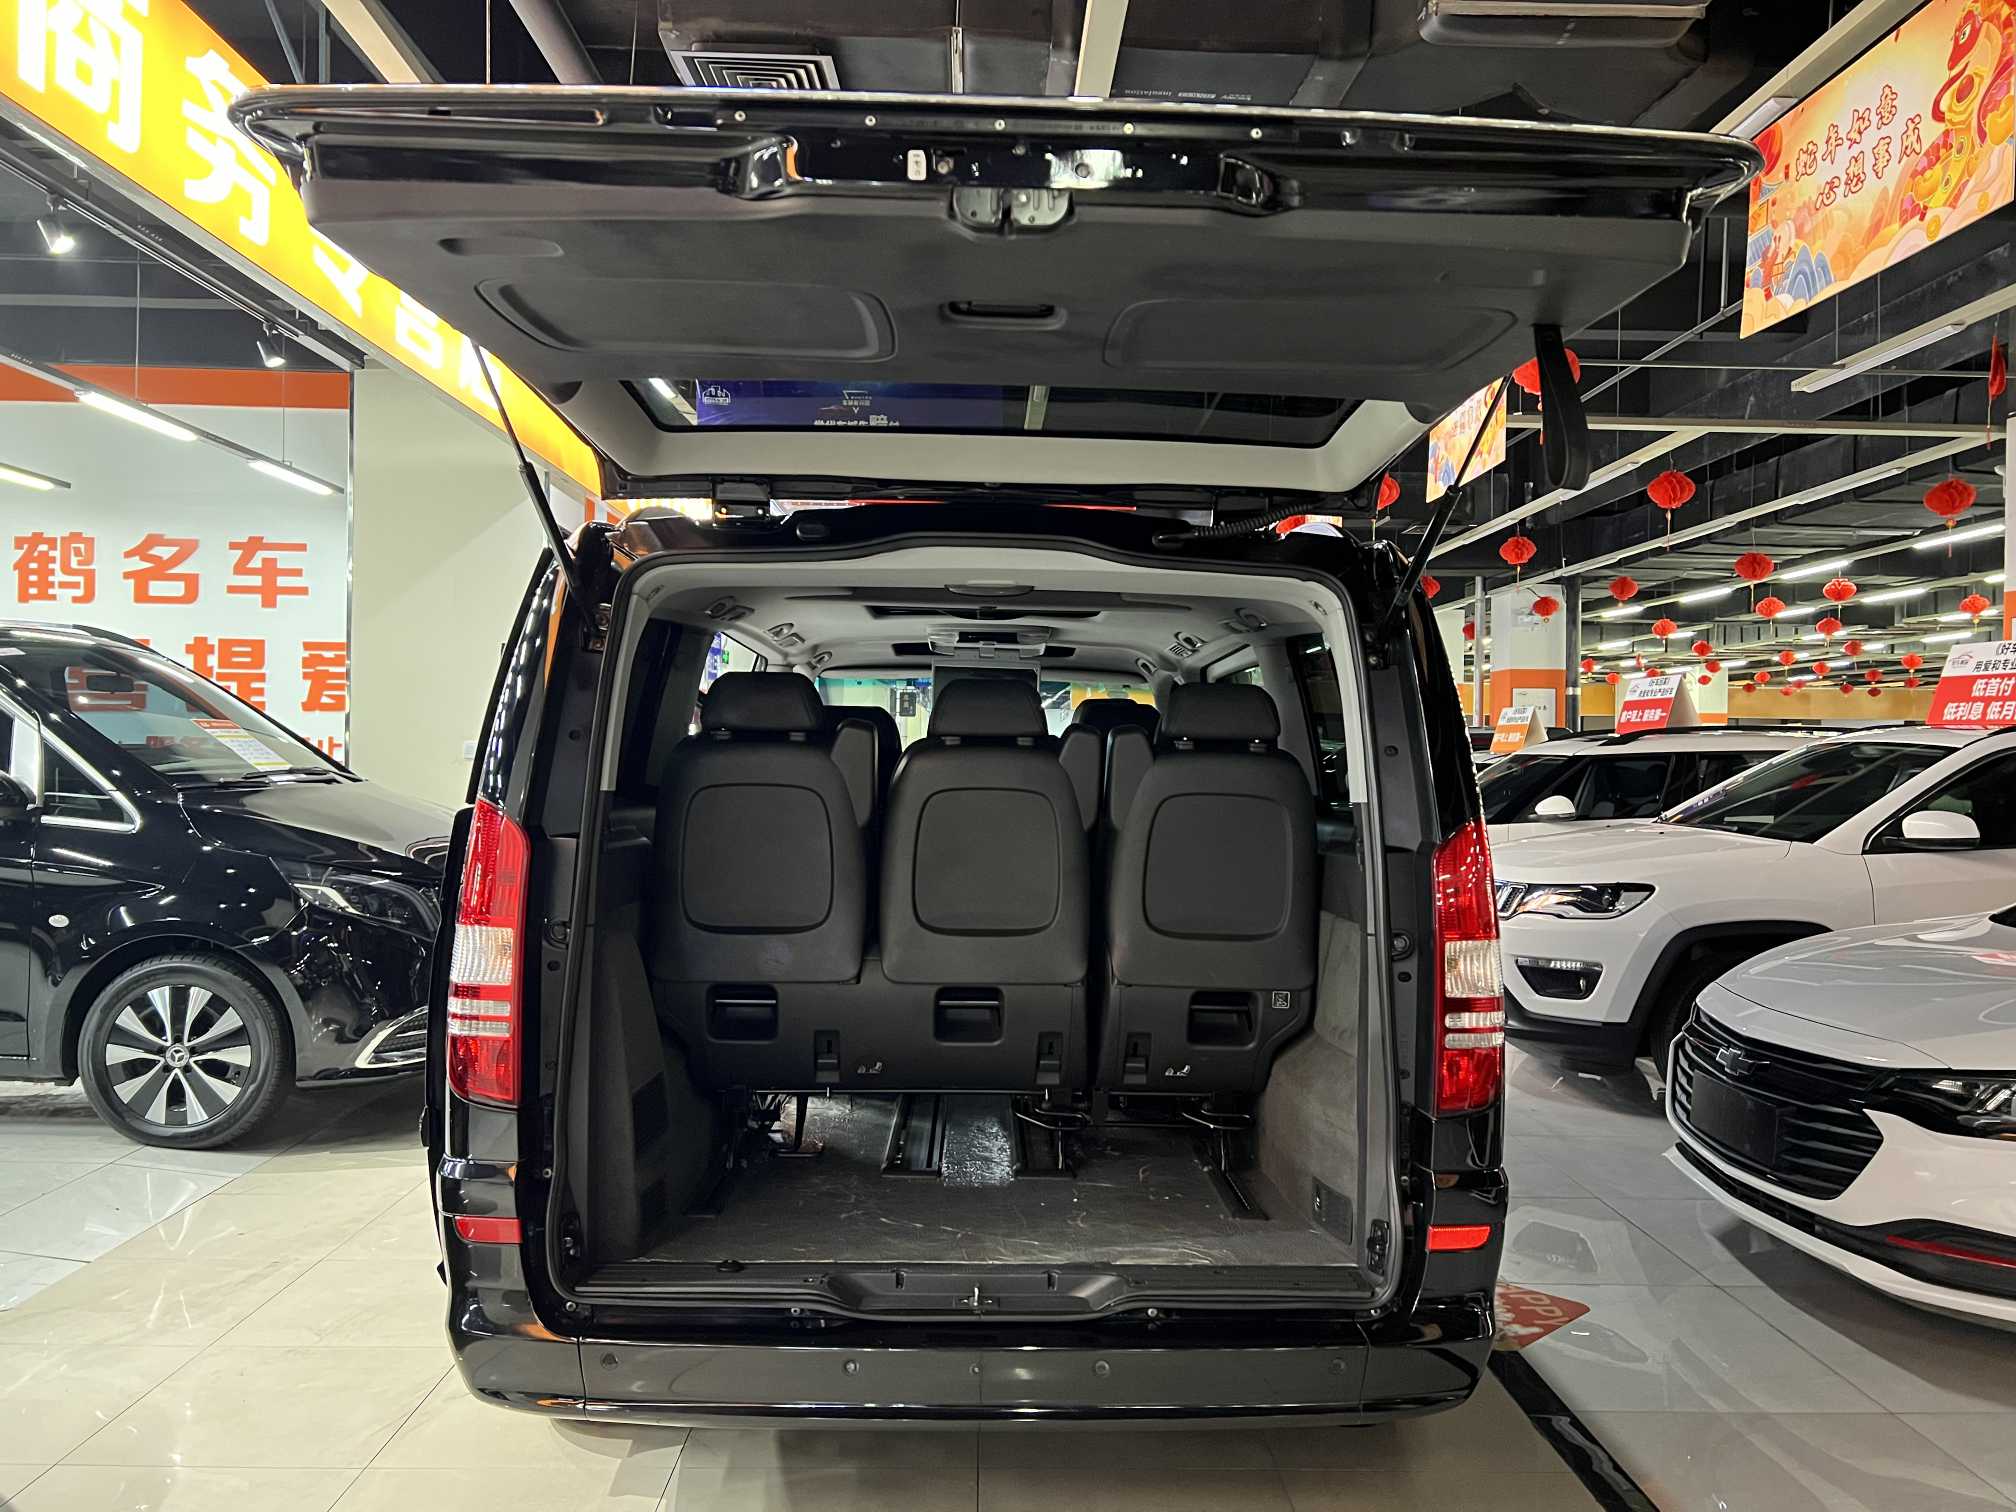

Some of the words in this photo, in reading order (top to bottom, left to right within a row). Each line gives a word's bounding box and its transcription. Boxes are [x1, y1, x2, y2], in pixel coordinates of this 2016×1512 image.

[1795, 84, 1898, 182] 蛇年如意
[1814, 114, 1923, 211] 心想事成
[12, 531, 310, 609] 鹤名车
[1942, 701, 1985, 721] 低利息
[1985, 700, 2016, 721] 低月
[1970, 676, 2016, 697] 低首付
